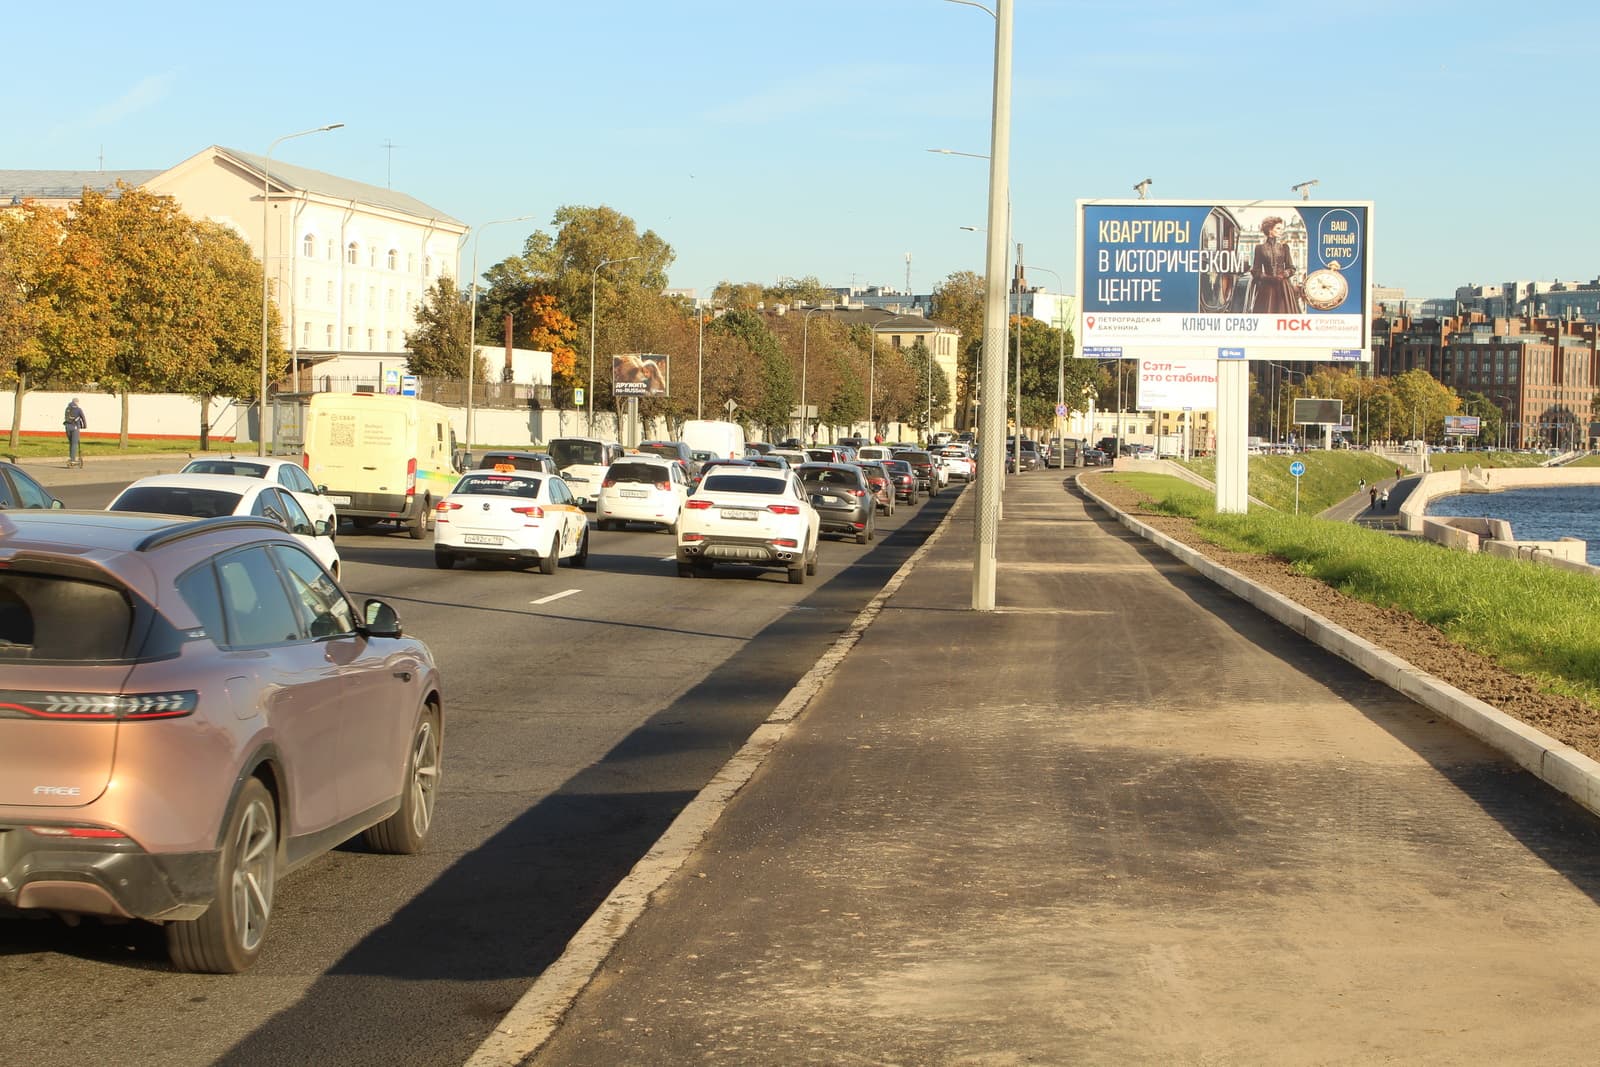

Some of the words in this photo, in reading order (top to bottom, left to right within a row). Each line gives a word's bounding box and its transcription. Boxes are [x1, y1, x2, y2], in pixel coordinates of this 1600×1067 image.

[1330, 220, 1348, 231] ВАШ
[1099, 220, 1190, 244] КВАРТИРЫ
[1323, 232, 1355, 245] ЛИЧНЫЙ
[1325, 247, 1352, 258] СТАТУС
[1098, 249, 1110, 273] В
[1115, 249, 1245, 273] ИСТОРИЧЕСКОМ
[1098, 279, 1162, 305] ЦЕНТРЕ
[1181, 317, 1221, 331] КЛЮЧИ
[1225, 318, 1259, 331] СРАЗУ
[1276, 319, 1312, 331] ПСК
[1142, 361, 1172, 371] Сэтл
[1142, 374, 1163, 382] это
